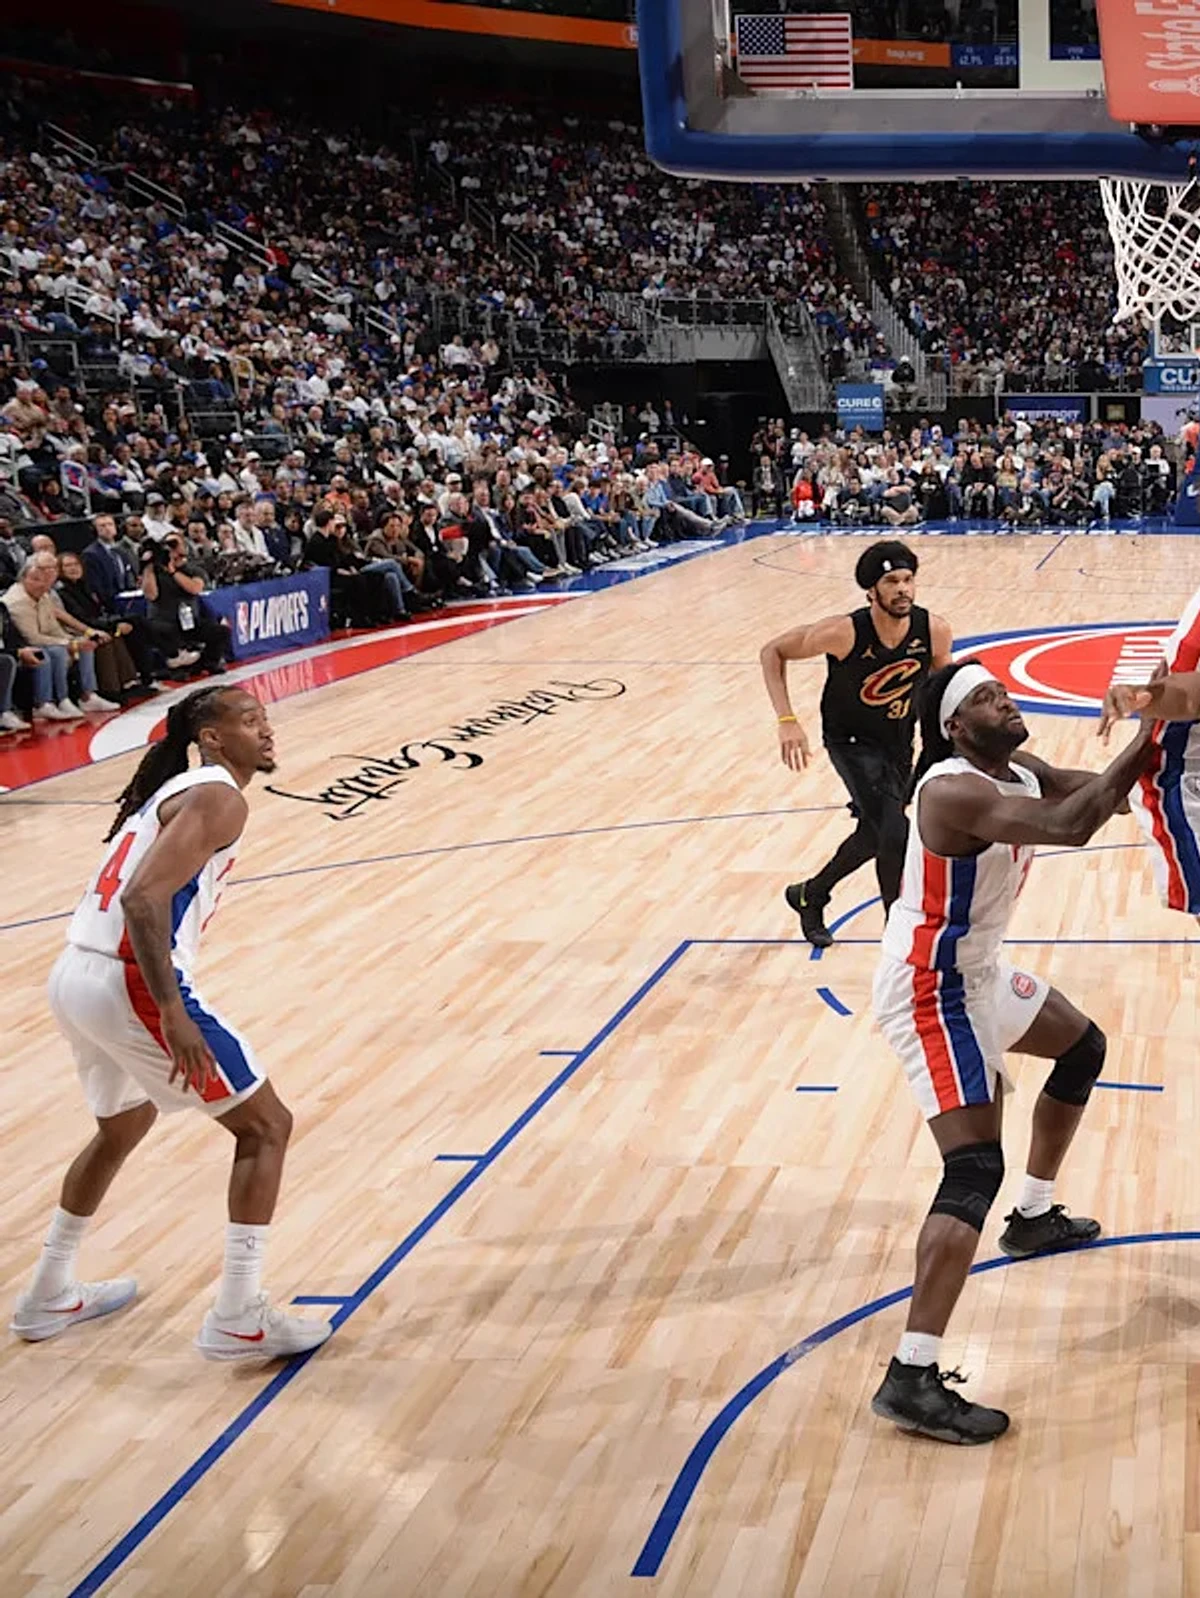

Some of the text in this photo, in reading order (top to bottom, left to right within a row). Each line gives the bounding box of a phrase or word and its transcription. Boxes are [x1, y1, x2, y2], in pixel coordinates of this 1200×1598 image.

[837, 396, 871, 407] CURE
[249, 590, 309, 641] PLAYOFFS
[95, 831, 137, 912] 4
